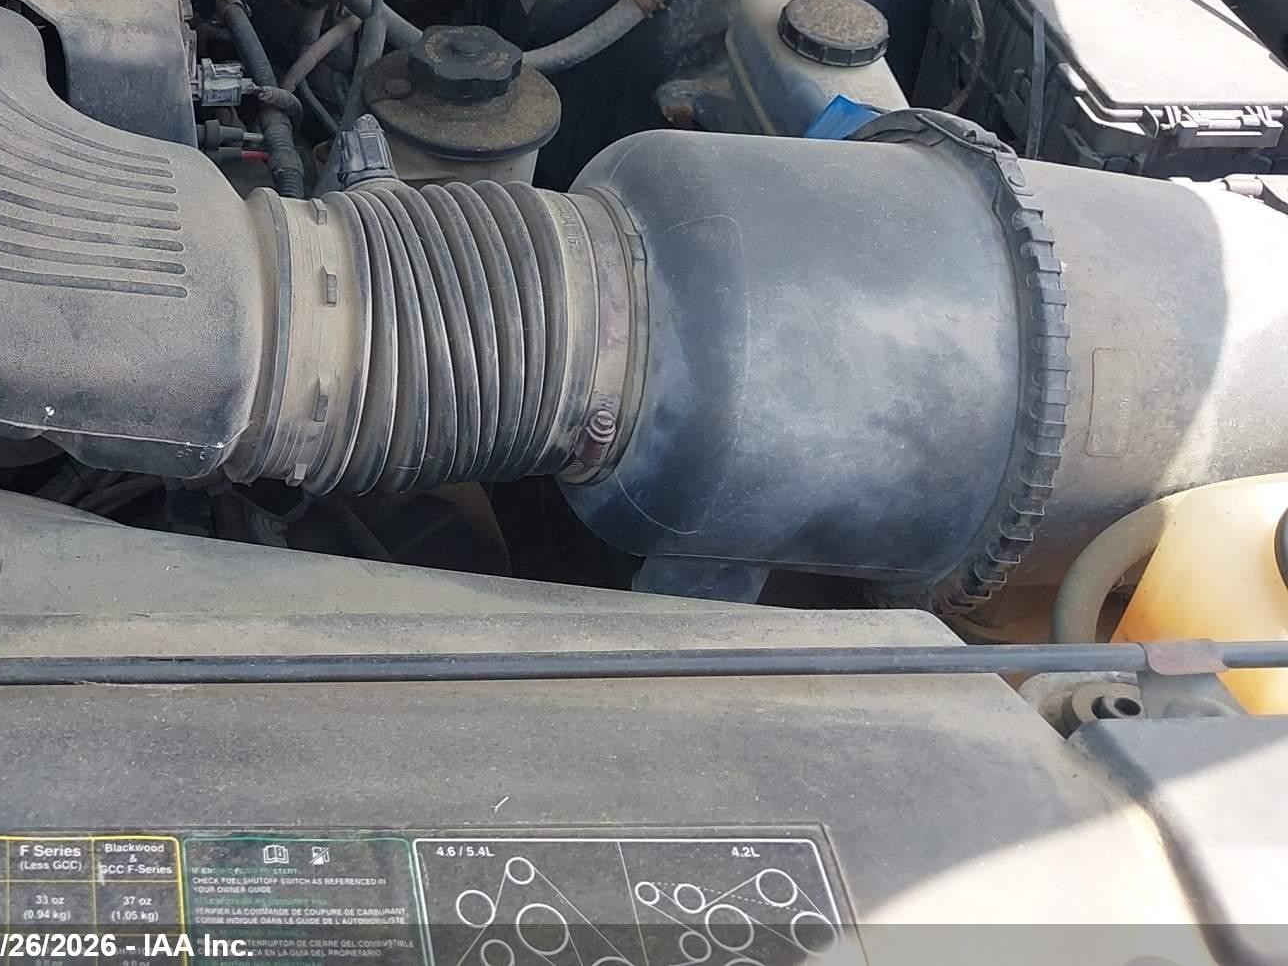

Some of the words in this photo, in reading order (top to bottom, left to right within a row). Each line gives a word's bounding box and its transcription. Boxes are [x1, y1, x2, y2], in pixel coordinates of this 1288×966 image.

[19, 845, 30, 857] F
[33, 844, 82, 858] Series
[104, 843, 165, 853] Blackwood
[436, 846, 456, 857] 4.6
[466, 846, 495, 858] 5.4L
[731, 846, 760, 858] 4.2L
[19, 860, 50, 872] (Less
[53, 860, 83, 872] GCC)
[127, 864, 173, 875] F-Series
[192, 876, 220, 885] CHECK
[35, 895, 49, 905] 33
[51, 896, 65, 905] oz
[122, 895, 135, 906] 37
[138, 897, 153, 906] oz
[23, 909, 51, 921] (0.94
[52, 909, 72, 921] kg)
[111, 910, 138, 922] (1.05
[140, 910, 160, 922] kg)
